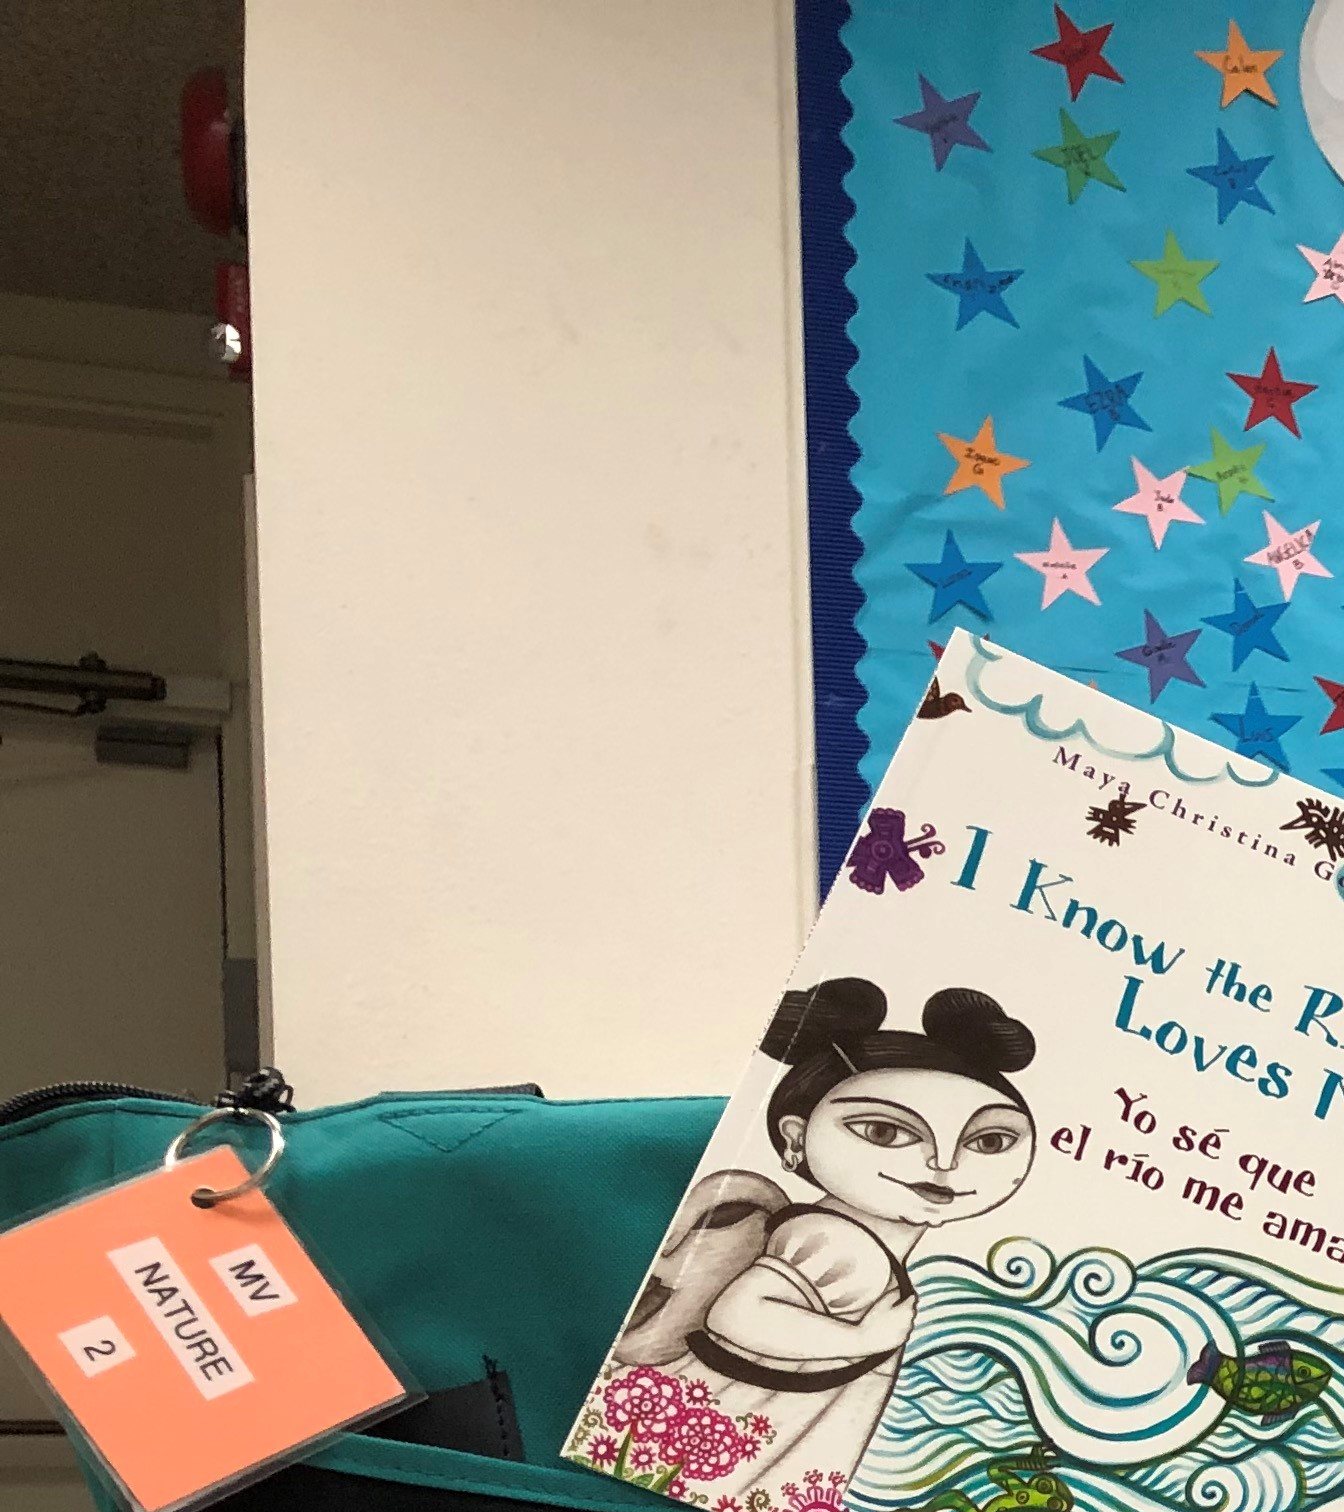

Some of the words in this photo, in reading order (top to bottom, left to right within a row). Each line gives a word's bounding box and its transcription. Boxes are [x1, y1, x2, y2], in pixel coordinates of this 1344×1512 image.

[1053, 744, 1131, 797] Maya
[1149, 787, 1298, 867] Christina
[950, 824, 995, 891] I
[1010, 855, 1188, 976] Know
[1206, 957, 1275, 1013] the
[1113, 972, 1293, 1101] Loves
[1048, 1121, 1092, 1165] el
[1103, 1143, 1165, 1192] río
[1181, 1177, 1245, 1222] me
[1112, 1085, 1157, 1137] Yo
[1172, 1124, 1231, 1160] sé
[1238, 1147, 1318, 1199] que
[134, 1261, 235, 1383] NATURE
[228, 1258, 281, 1303] MV
[82, 1340, 117, 1362] 2
